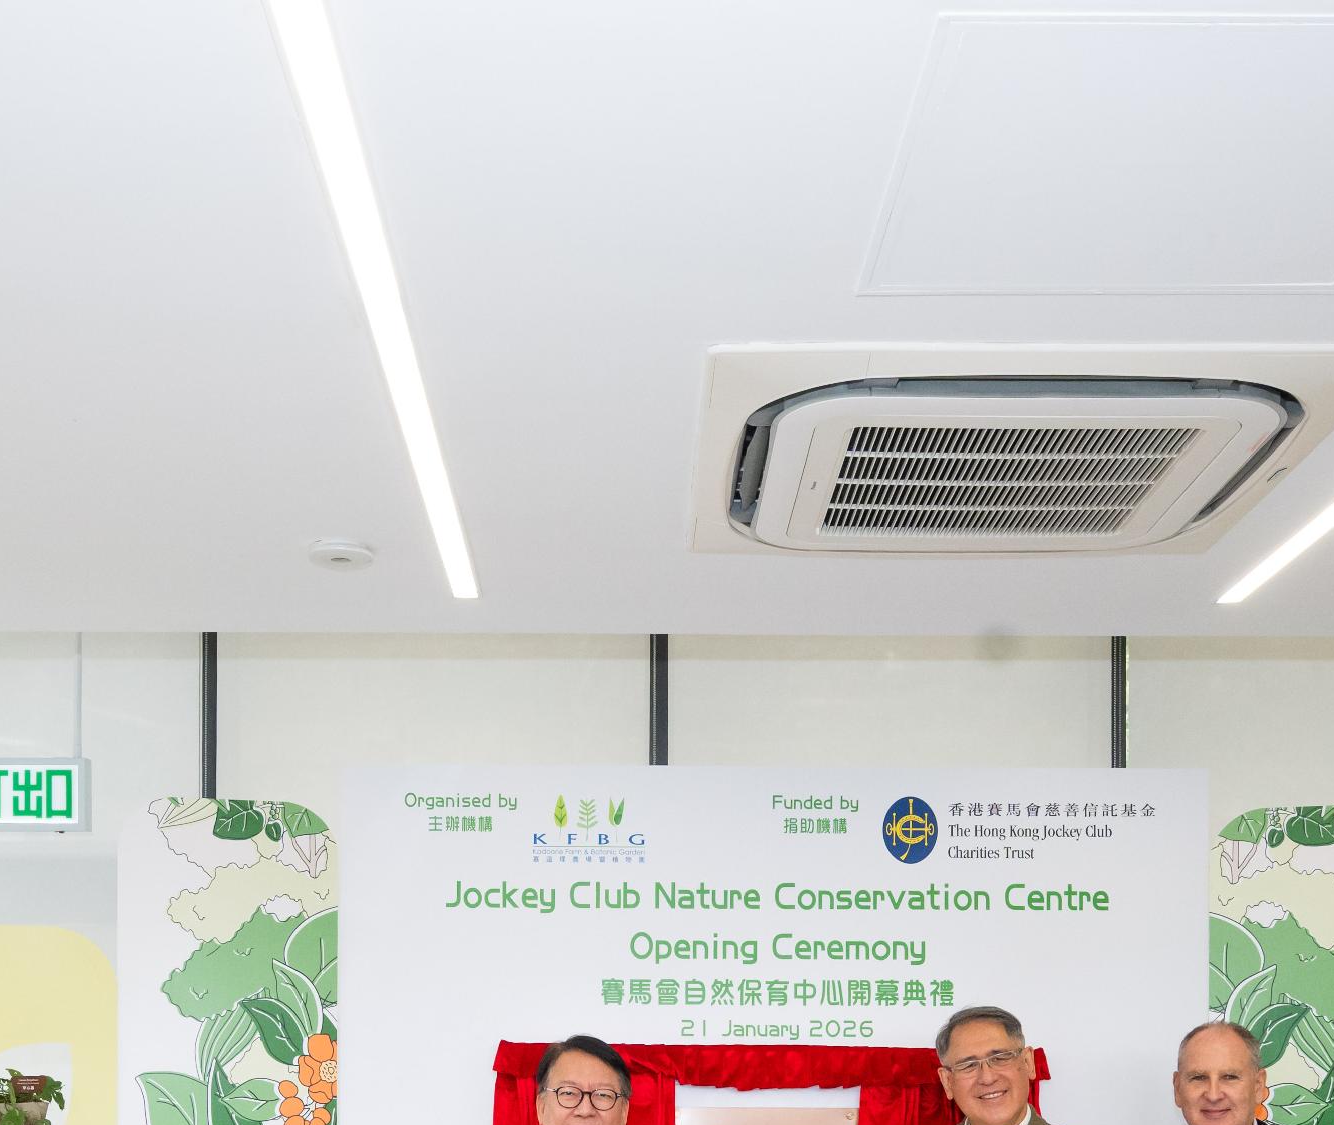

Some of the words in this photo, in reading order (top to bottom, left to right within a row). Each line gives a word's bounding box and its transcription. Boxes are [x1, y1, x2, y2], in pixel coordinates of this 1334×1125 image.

[13, 770, 72, 818] 出口
[404, 793, 491, 810] Organised
[498, 793, 517, 811] by
[772, 794, 833, 810] Funded
[840, 795, 859, 812] by
[948, 802, 1156, 818] 香港賽馬會慈善信託基金
[428, 815, 493, 833] 主辦機構
[783, 817, 848, 834] 捐助機構
[948, 823, 971, 838] The
[974, 824, 1007, 841] Hong
[1009, 824, 1040, 841] Kong
[1041, 824, 1083, 842] Jockey
[1085, 824, 1113, 838] Club
[948, 845, 1000, 860] Charities
[1003, 846, 1035, 860] Trust
[445, 879, 556, 914] Jockey
[569, 881, 641, 909] Club
[654, 881, 761, 910] Nature
[774, 882, 991, 912] Conservation
[1004, 883, 1110, 912] Centre
[629, 931, 758, 965] Opening
[771, 933, 927, 966] Ceremony
[601, 977, 955, 1007] 賽馬會自然保育中心開幕典禮
[681, 1019, 706, 1037] 21
[722, 1019, 800, 1041] January
[809, 1019, 874, 1038] 2026
